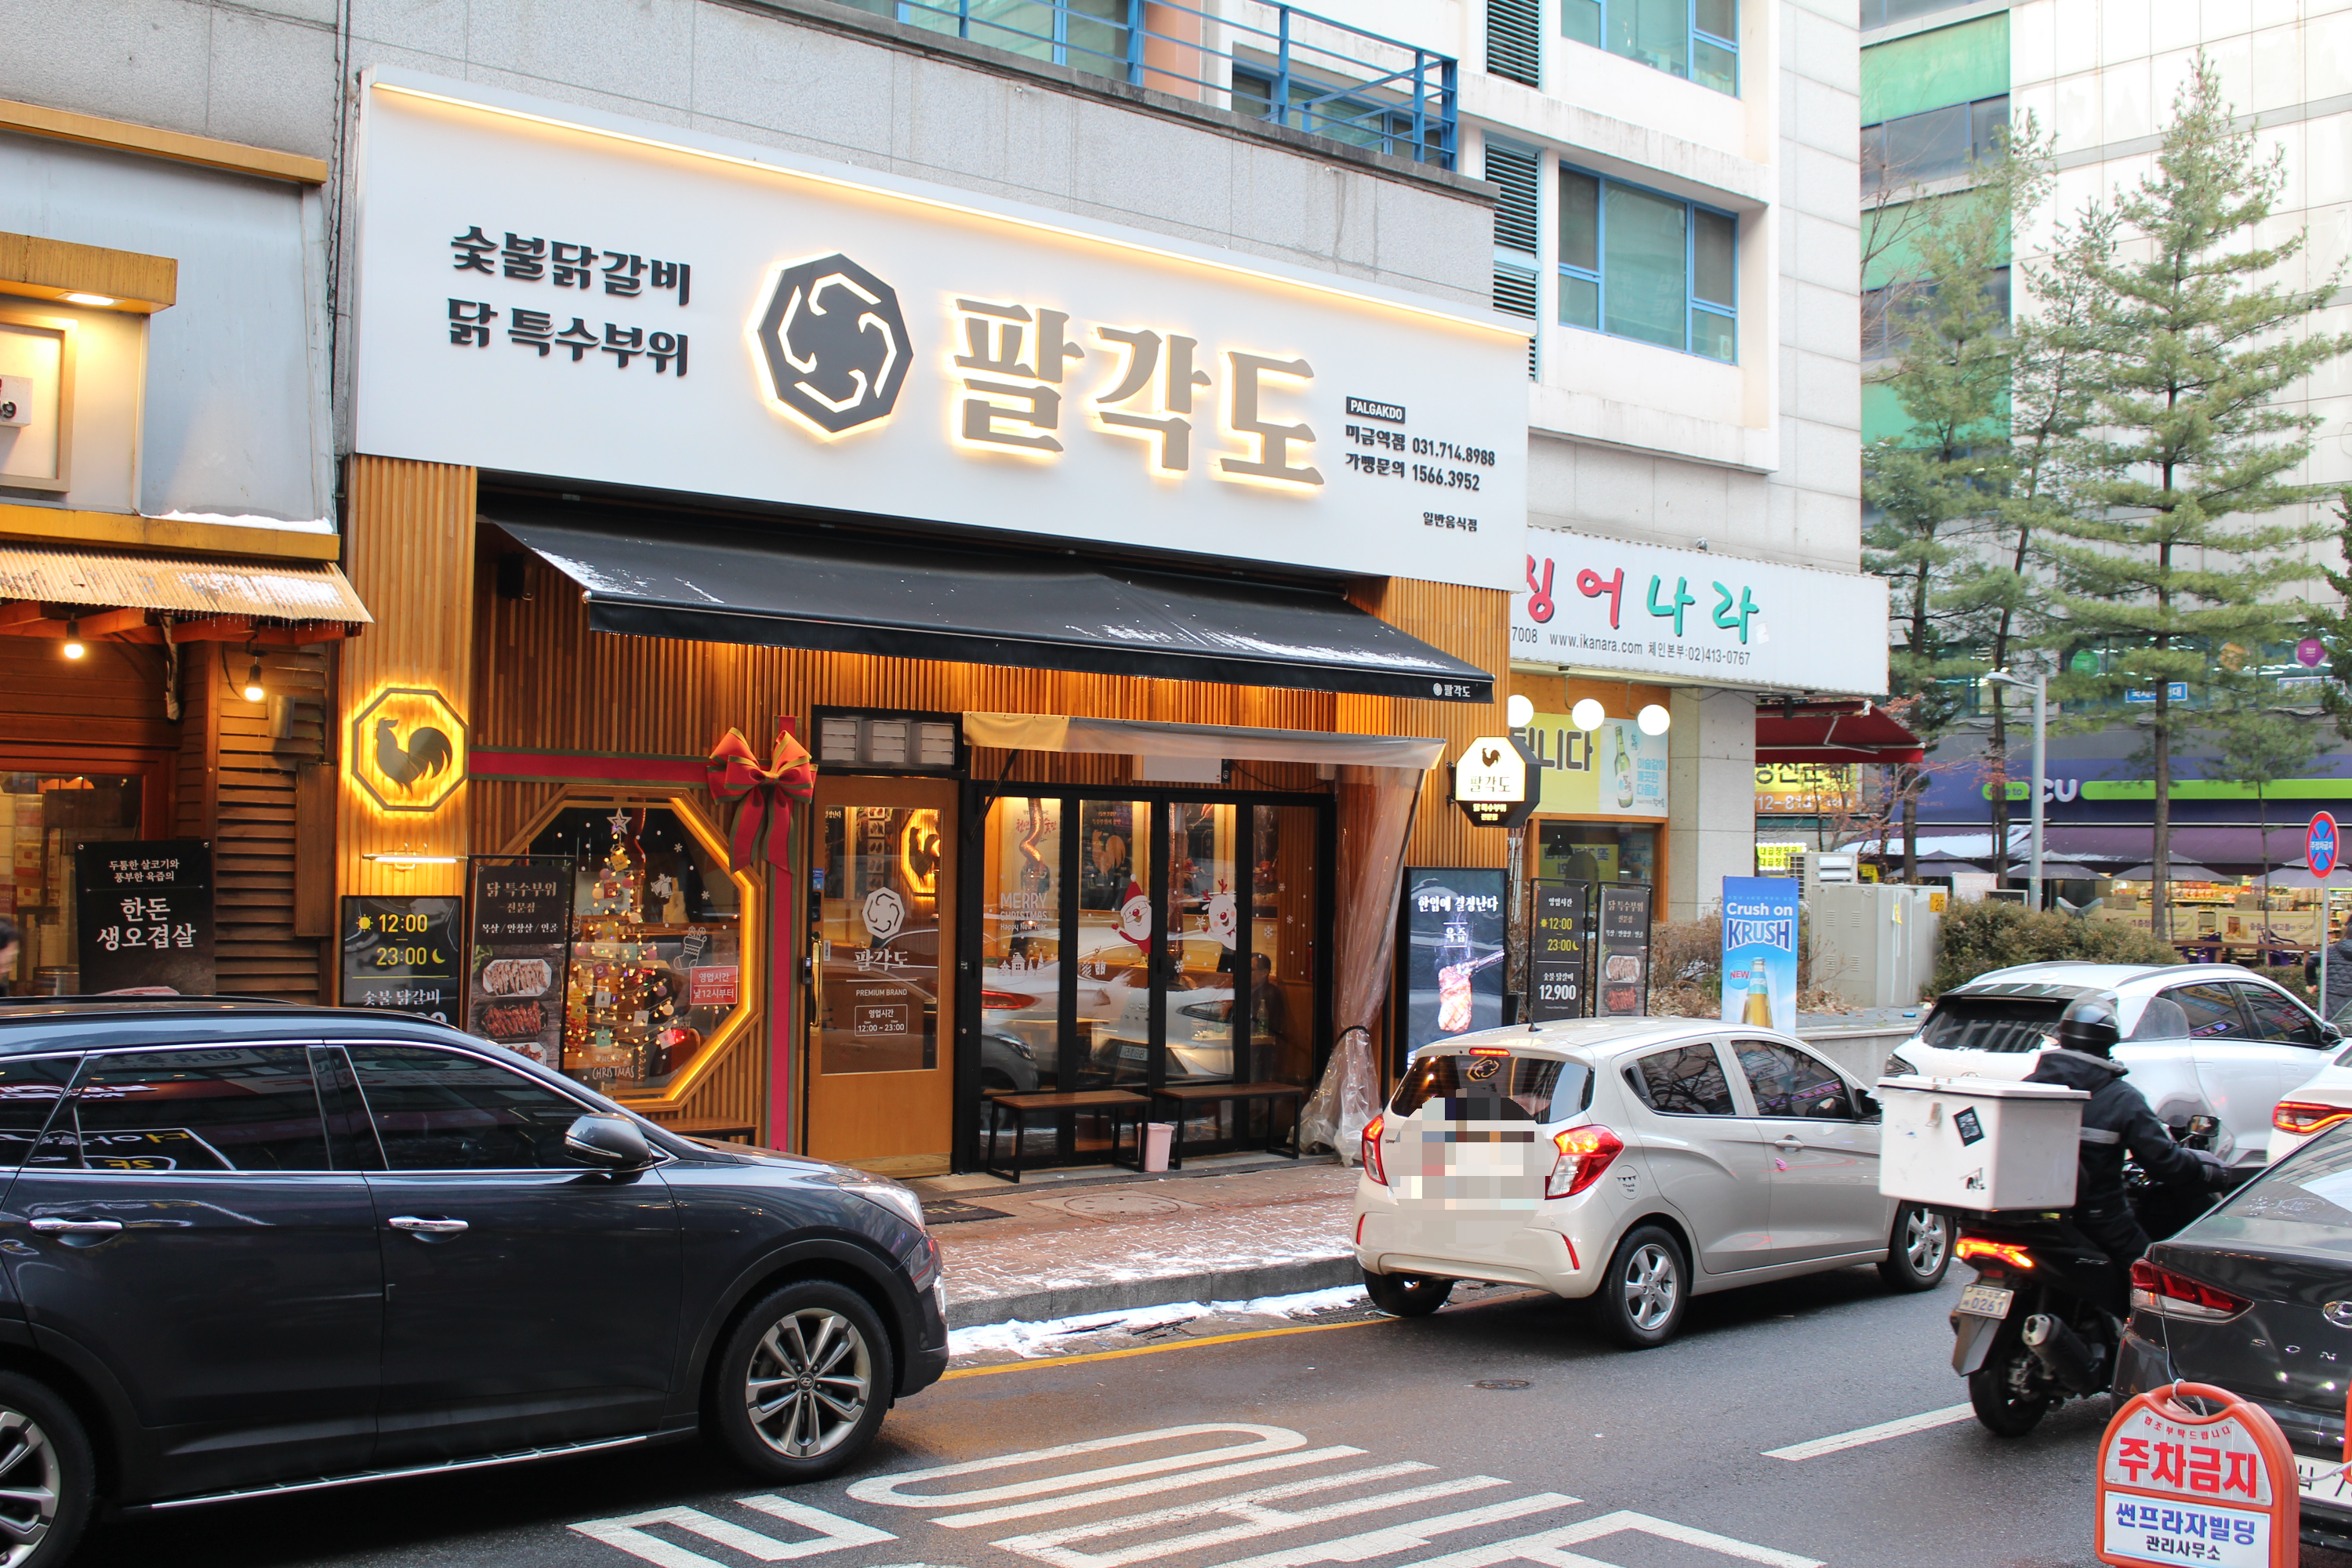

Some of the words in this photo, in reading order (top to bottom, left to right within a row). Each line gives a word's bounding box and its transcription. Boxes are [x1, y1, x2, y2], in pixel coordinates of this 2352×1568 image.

[451, 225, 691, 307] 숯불닭갈비
[448, 298, 498, 348] 닭
[507, 307, 688, 377] 특수부위
[955, 298, 1325, 485] 팔각도
[1350, 399, 1403, 420] PALGAKDO
[1345, 424, 1406, 452] 미금역점
[1412, 437, 1496, 466] 031.714.8988
[1345, 453, 1406, 478] 가맹문의
[1412, 464, 1480, 492] 1566.3952
[1423, 511, 1478, 532] 일반음식점
[1549, 632, 1643, 655] www.ikanara.com
[1443, 684, 1471, 697] 팔각도
[1470, 776, 1511, 793] 팔각도
[2309, 840, 2334, 851] 주정차금지
[109, 859, 139, 871] 두툼한
[140, 858, 180, 870] 살코기와
[114, 872, 144, 883] 풍부한
[146, 870, 175, 882] 육즙의
[487, 882, 501, 897] 닭
[503, 882, 557, 897] 특수부위
[1000, 892, 1047, 909] MERRY
[1417, 895, 1451, 913] 한입에
[1454, 895, 1499, 913] 결정난다
[1548, 897, 1573, 908] 영업시간
[1726, 902, 1770, 916] Crush
[1773, 906, 1794, 916] on
[120, 897, 171, 922] 한돈
[1000, 910, 1047, 921] CHRISTMAS
[379, 914, 428, 933] 12:00
[1000, 923, 1019, 932] Happy
[1548, 917, 1573, 930] 12:00
[96, 923, 197, 951] 생오겹살
[1444, 927, 1468, 943] 육즙
[1726, 917, 1793, 953] KRUSH
[1547, 939, 1572, 952] 23:00
[376, 947, 427, 966] 23:00
[853, 949, 909, 971] 팔각도
[699, 972, 730, 983] 영업시간
[1730, 970, 1750, 980] NEW
[362, 989, 393, 1006] 숯불
[396, 989, 440, 1005] 닭갈비
[693, 988, 735, 1000] 낮12시부터
[1538, 984, 1577, 1001] 12,900
[868, 1008, 894, 1018] 영업시간
[858, 1024, 878, 1033] 12:00
[884, 1023, 905, 1032] 23:00
[592, 1065, 635, 1080] CHRISTMAS
[2118, 1436, 2257, 1499] 주차금지
[2116, 1501, 2256, 1546] 썬프라자빌딩
[2145, 1534, 2221, 1562] 관리사무소
